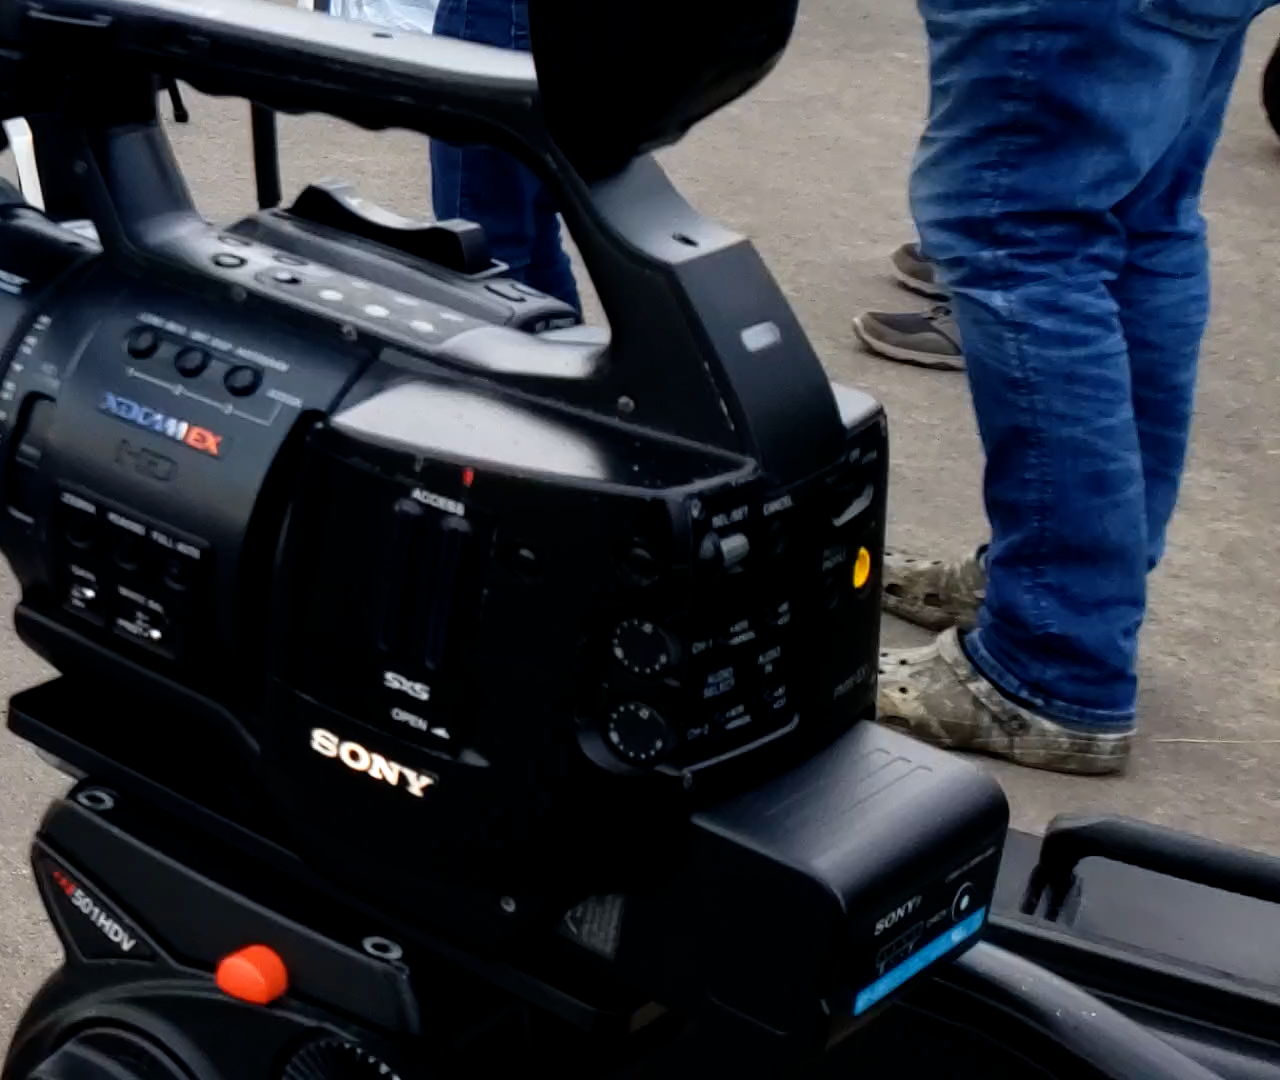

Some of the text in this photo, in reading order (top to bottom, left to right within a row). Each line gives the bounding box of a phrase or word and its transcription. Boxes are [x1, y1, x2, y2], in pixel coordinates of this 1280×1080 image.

[390, 706, 429, 732] OPEN
[310, 726, 435, 798] SONY
[873, 895, 922, 936] SONY
